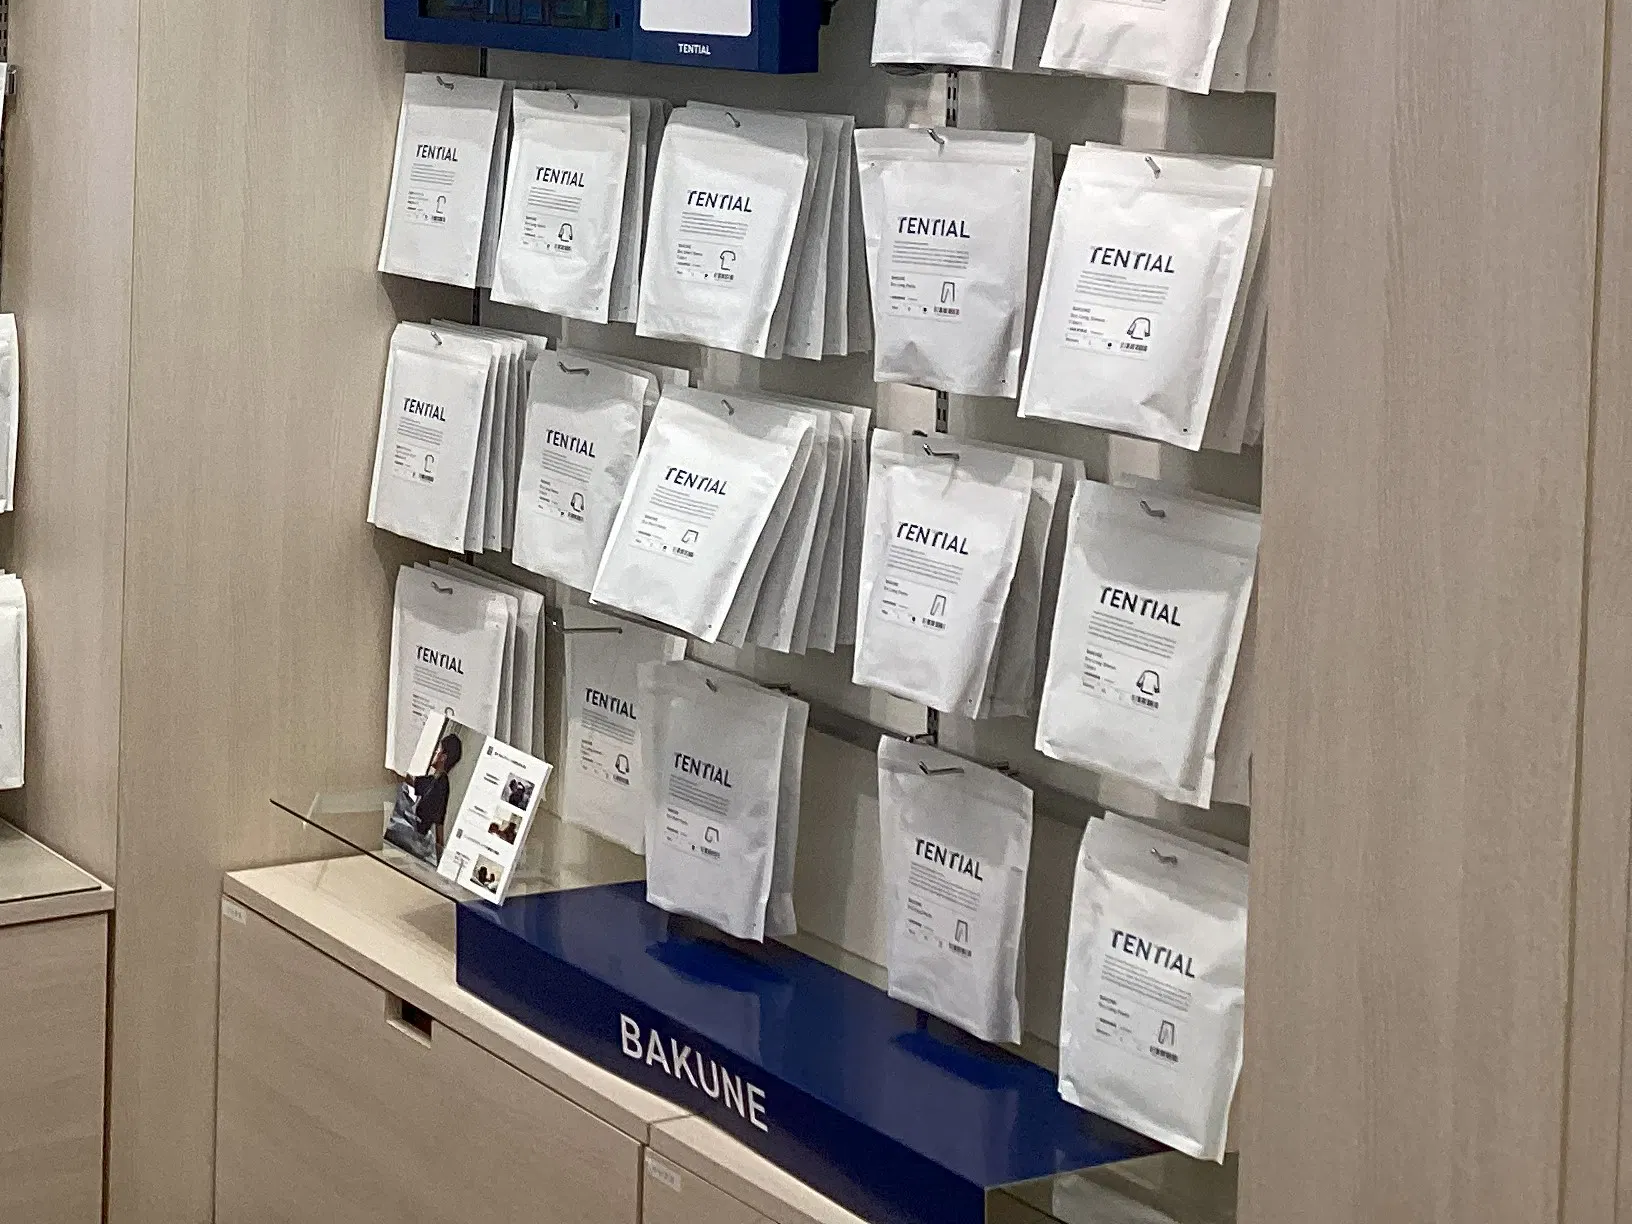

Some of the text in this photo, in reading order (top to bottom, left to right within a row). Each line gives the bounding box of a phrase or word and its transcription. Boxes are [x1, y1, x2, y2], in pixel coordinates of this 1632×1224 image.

[678, 42, 712, 55] TENTIAL
[415, 144, 458, 162] TENTIAL
[535, 166, 585, 188] TENTIAL
[686, 190, 752, 213] TENTIAL
[897, 216, 971, 239] TENTIAL
[1089, 246, 1174, 274] TENTIAL
[403, 398, 446, 422] TENTIAL
[545, 429, 595, 458] TENTIAL
[664, 467, 727, 496] TENTIAL
[896, 522, 968, 555] TENTIAL
[1100, 587, 1181, 627] TENTIAL
[415, 645, 464, 675] TENTIAL
[584, 688, 637, 720] TENTIAL
[673, 753, 732, 788] TENTIAL
[915, 839, 983, 881] TENTIAL
[1110, 930, 1195, 979] TENTIAL
[619, 1012, 770, 1133] BAKUNE
